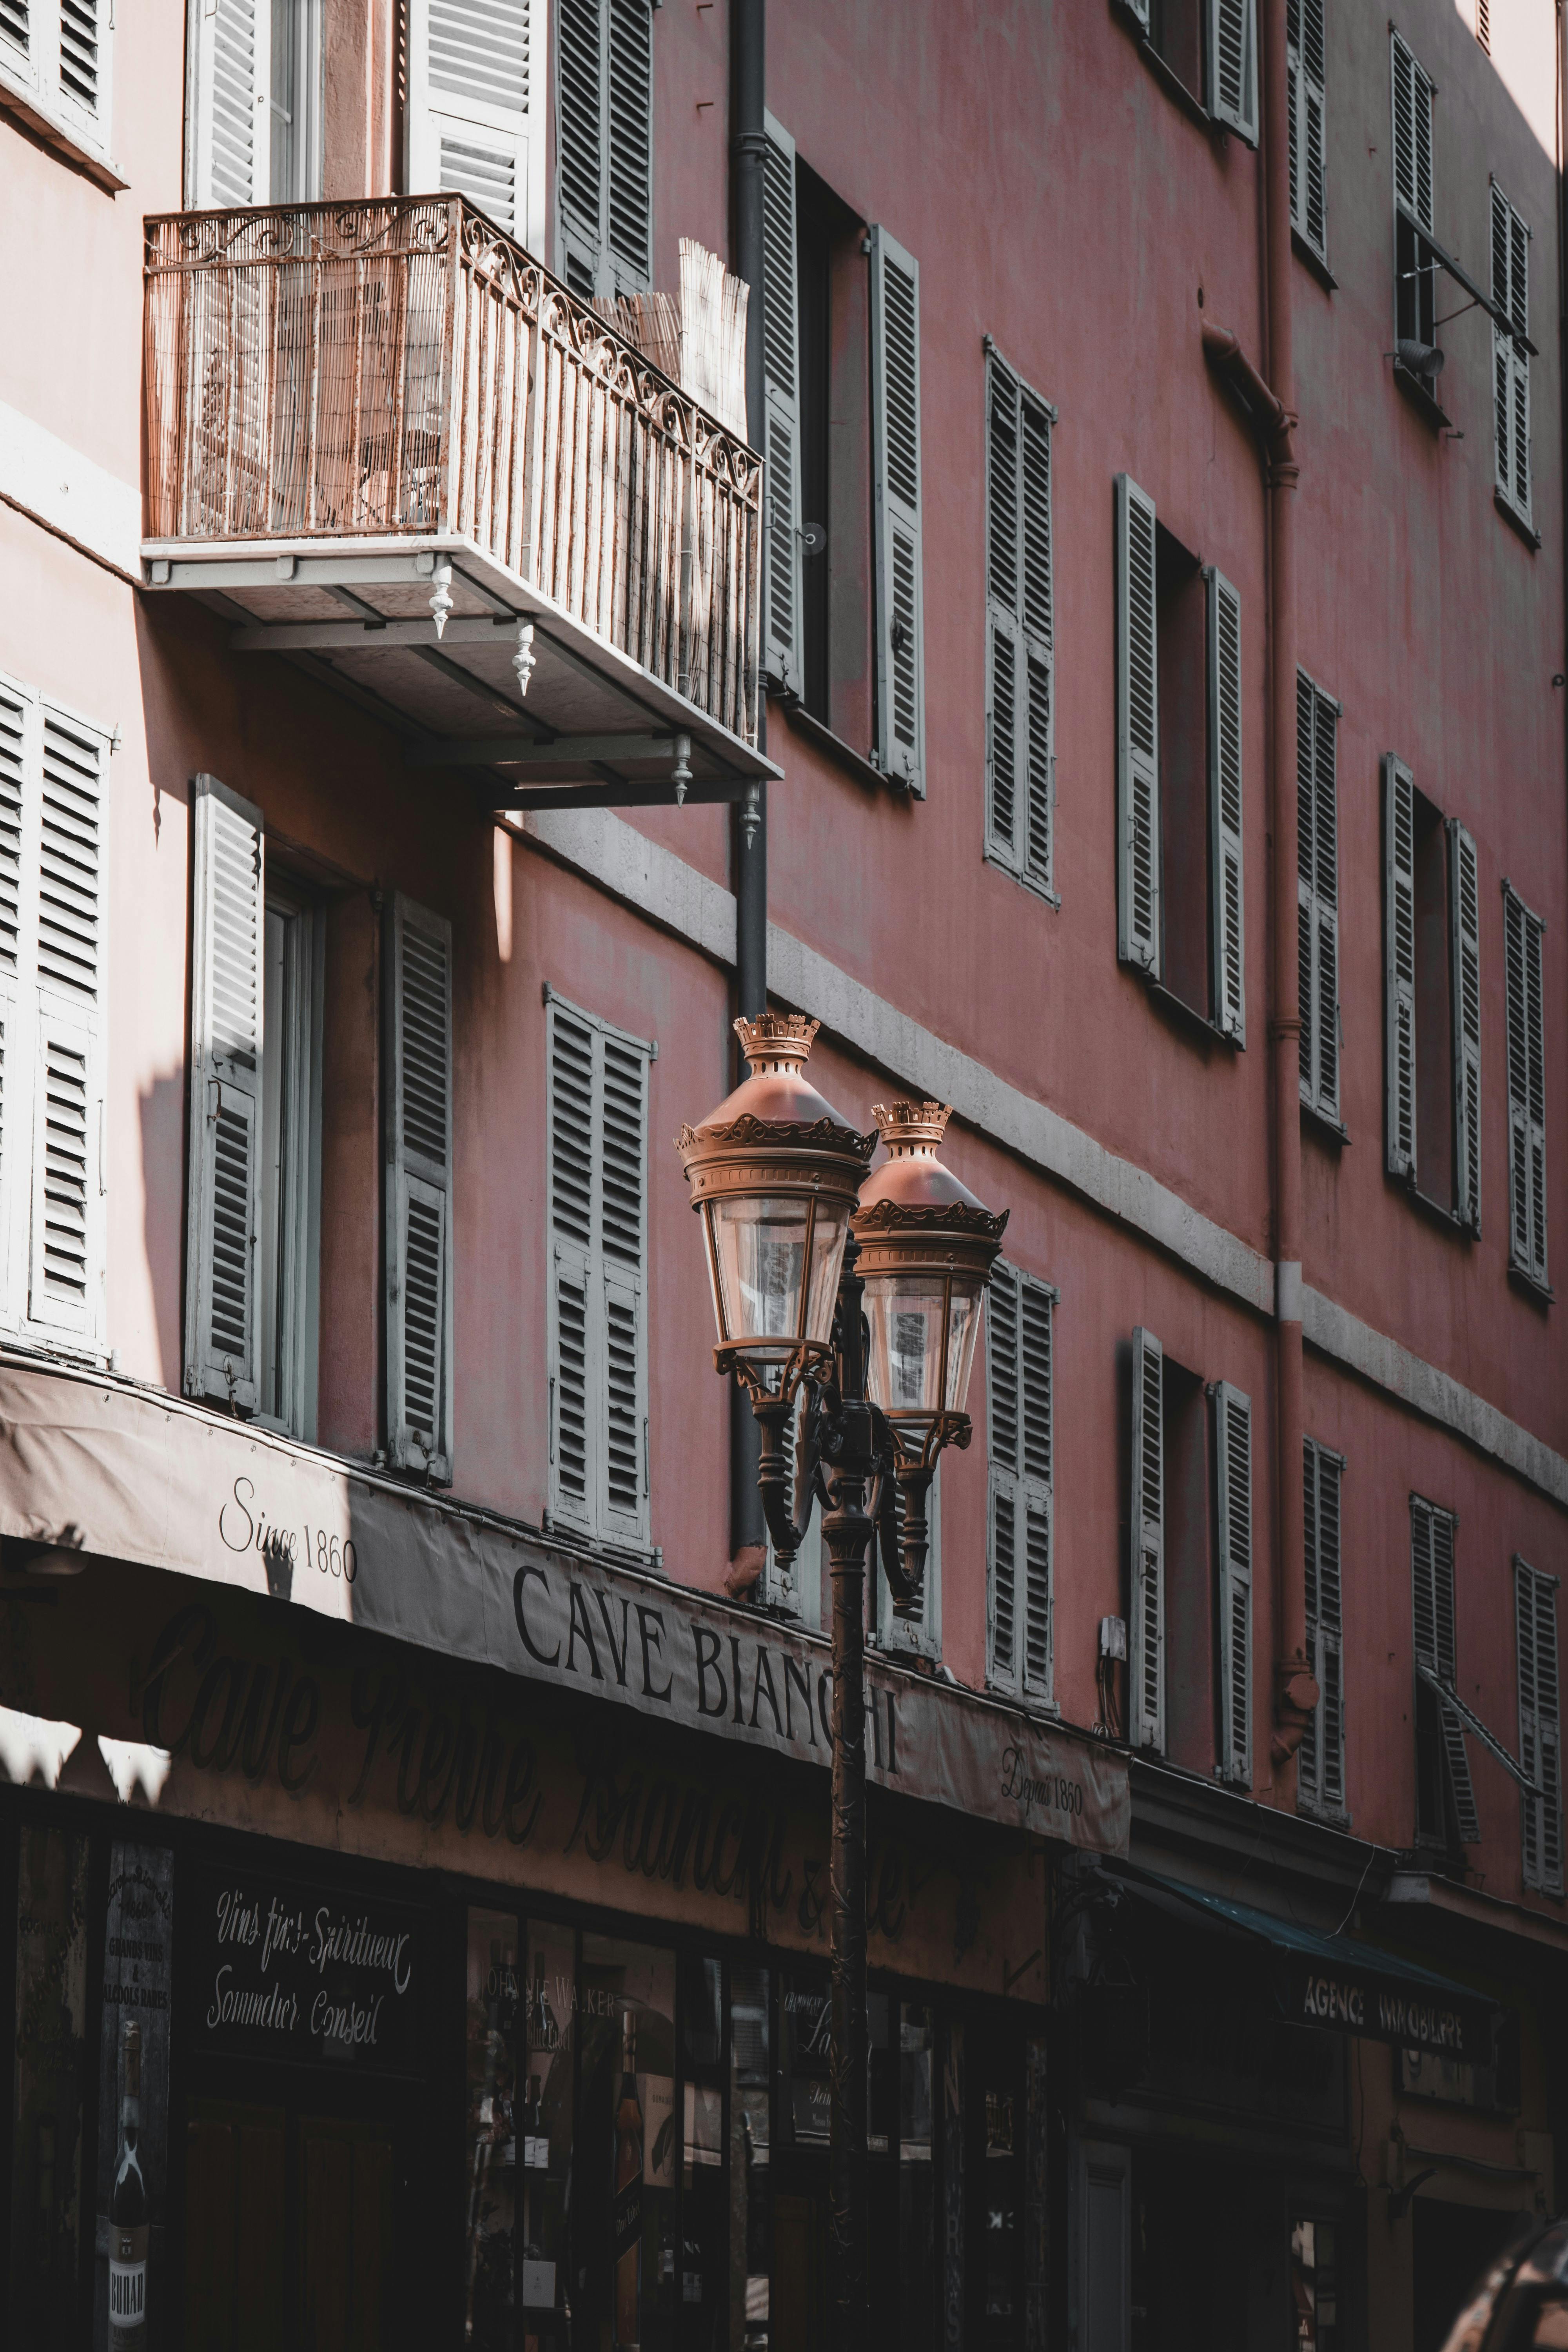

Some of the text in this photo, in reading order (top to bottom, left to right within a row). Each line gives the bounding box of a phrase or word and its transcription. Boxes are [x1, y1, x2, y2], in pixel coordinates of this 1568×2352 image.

[219, 1477, 358, 1584] Since 1860
[513, 1565, 673, 1704] CAVE
[142, 1602, 321, 1792] Cave
[1002, 1747, 1083, 1817] Depuis 1860
[216, 1889, 261, 1946] Vins
[109, 1937, 163, 1963] GRANDS VINS
[103, 1984, 139, 2006] ALCOOLS
[310, 1990, 385, 2045] Conseil
[555, 1984, 615, 2018] WAKER
[1304, 1975, 1365, 2025] AGENCE
[111, 2272, 143, 2315] BUNAN
